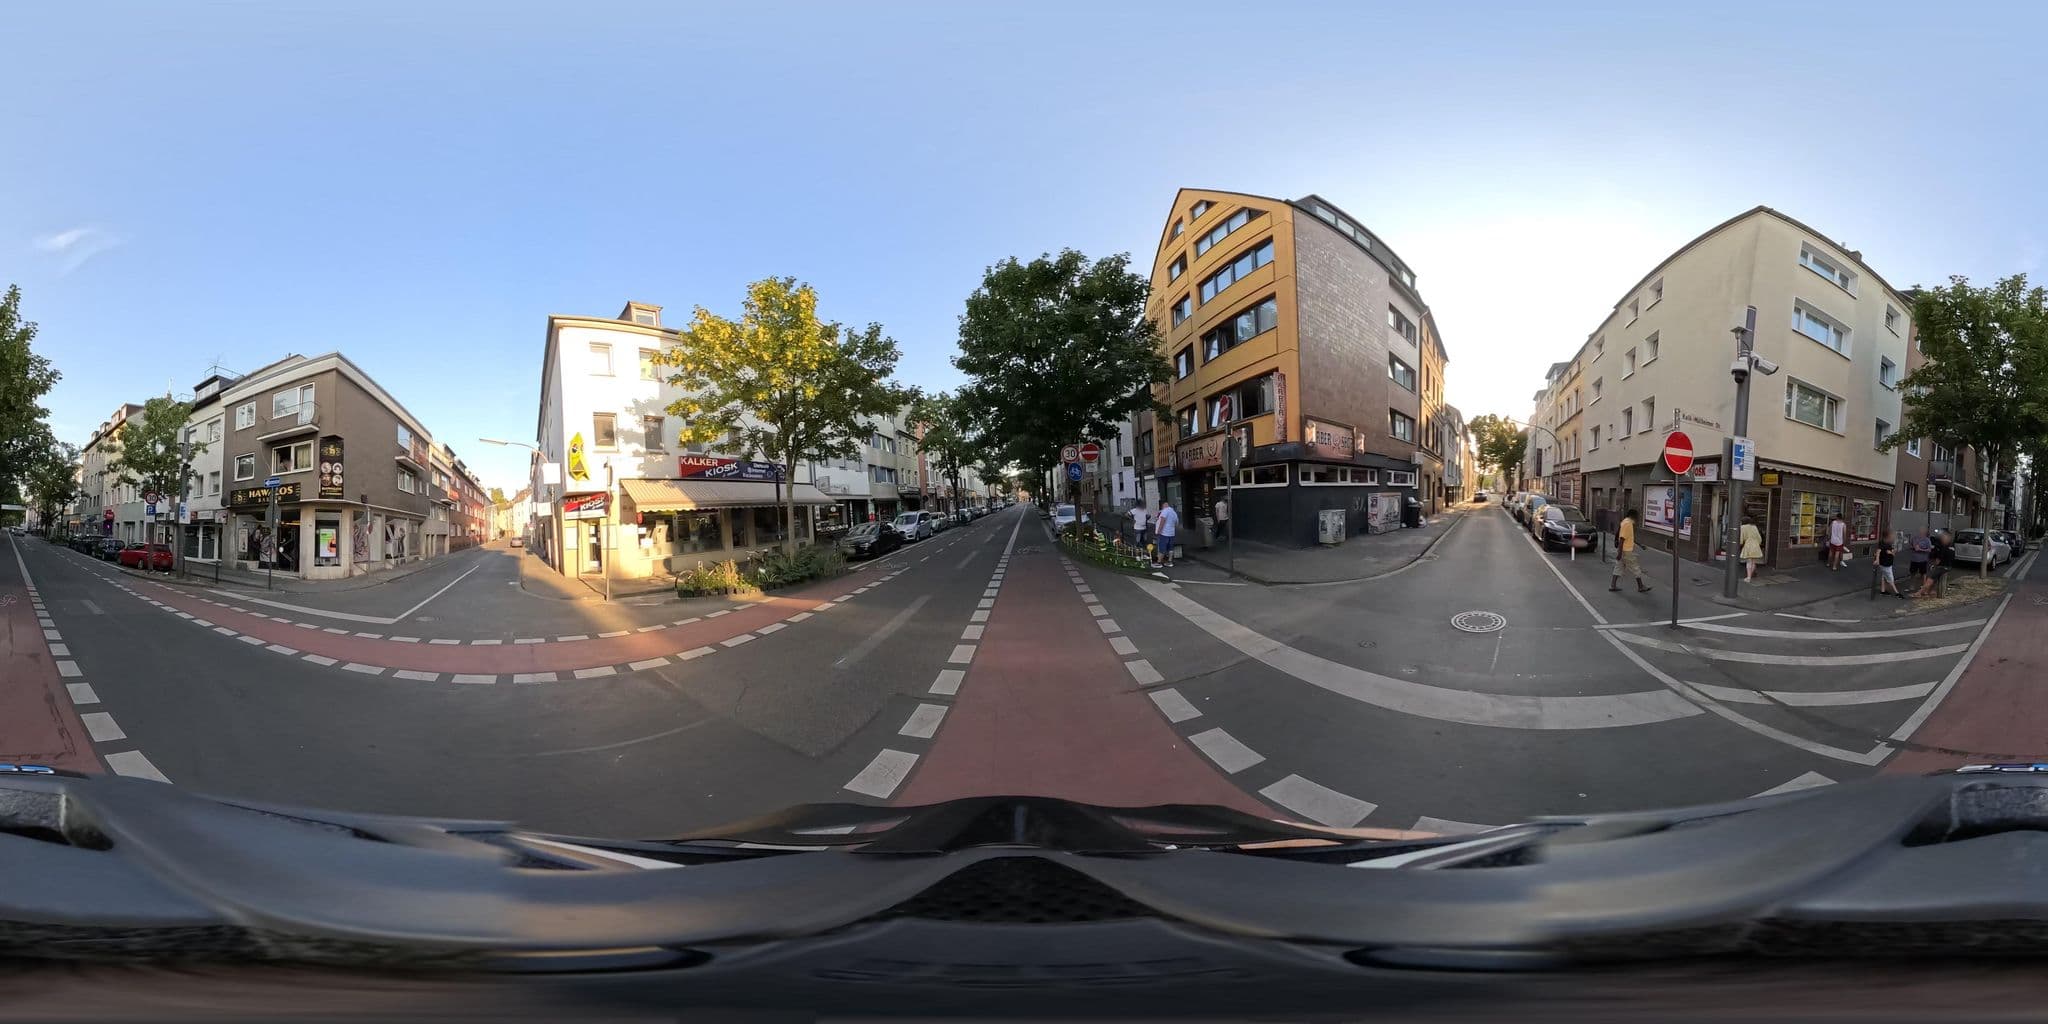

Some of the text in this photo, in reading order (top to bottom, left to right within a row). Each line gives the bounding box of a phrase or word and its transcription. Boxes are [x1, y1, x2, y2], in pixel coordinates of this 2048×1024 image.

[1064, 449, 1076, 458] 30
[680, 456, 719, 467] KALKER
[704, 461, 739, 478] KIOSK
